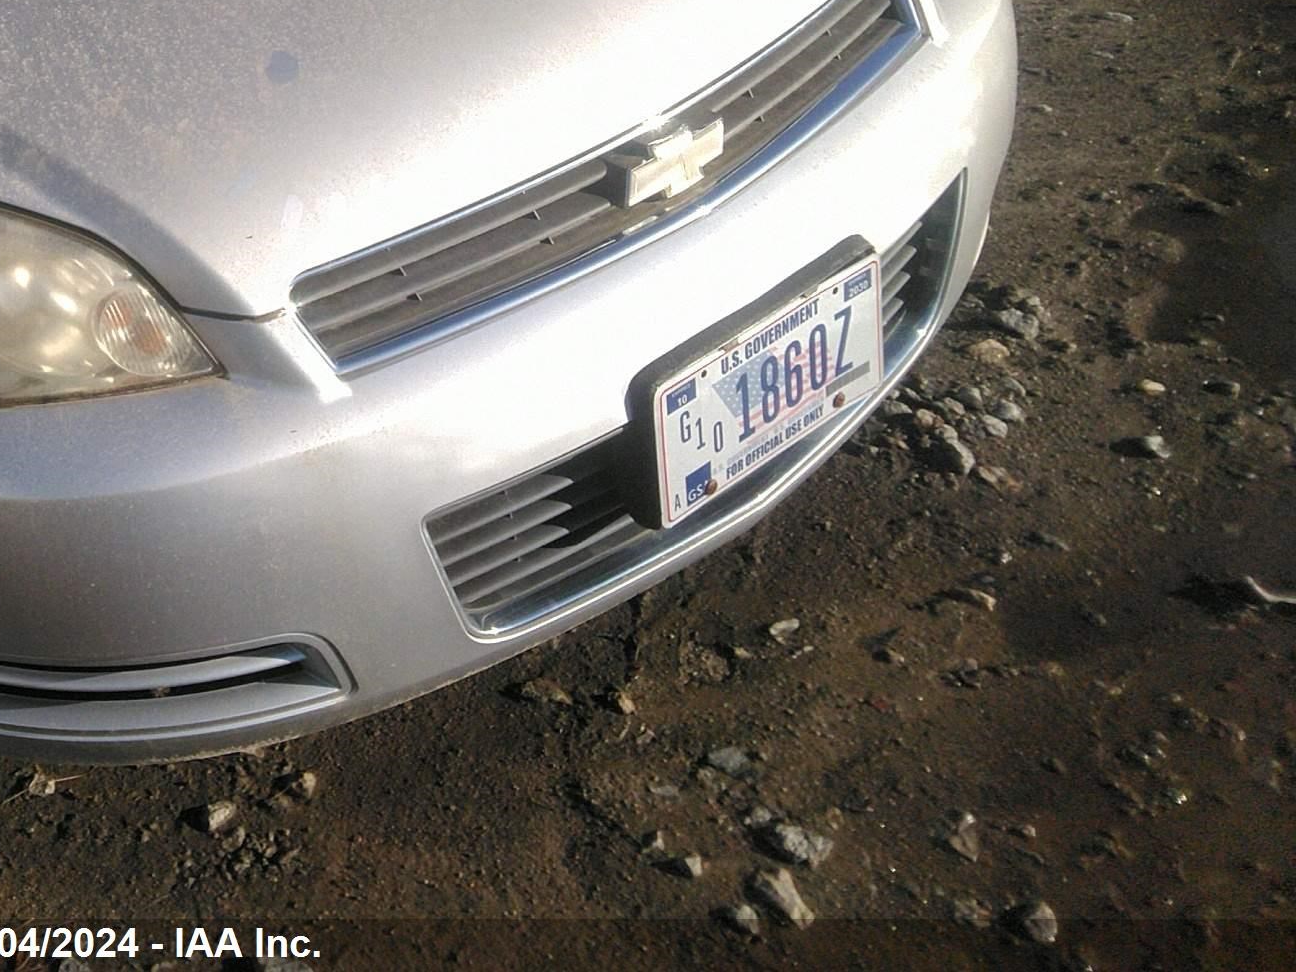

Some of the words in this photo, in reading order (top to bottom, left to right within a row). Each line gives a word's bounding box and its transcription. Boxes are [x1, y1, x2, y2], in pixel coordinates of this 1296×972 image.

[721, 350, 743, 375] U.S.
[745, 298, 819, 360] GOVERNMENT
[736, 305, 853, 441] 1860Z
[677, 394, 688, 407] 10
[726, 459, 743, 480] FOR
[745, 431, 784, 466] OFFICIAL
[785, 417, 802, 440] USE
[803, 403, 824, 427] ONLY
[674, 493, 682, 511] A
[688, 480, 709, 502] GS
